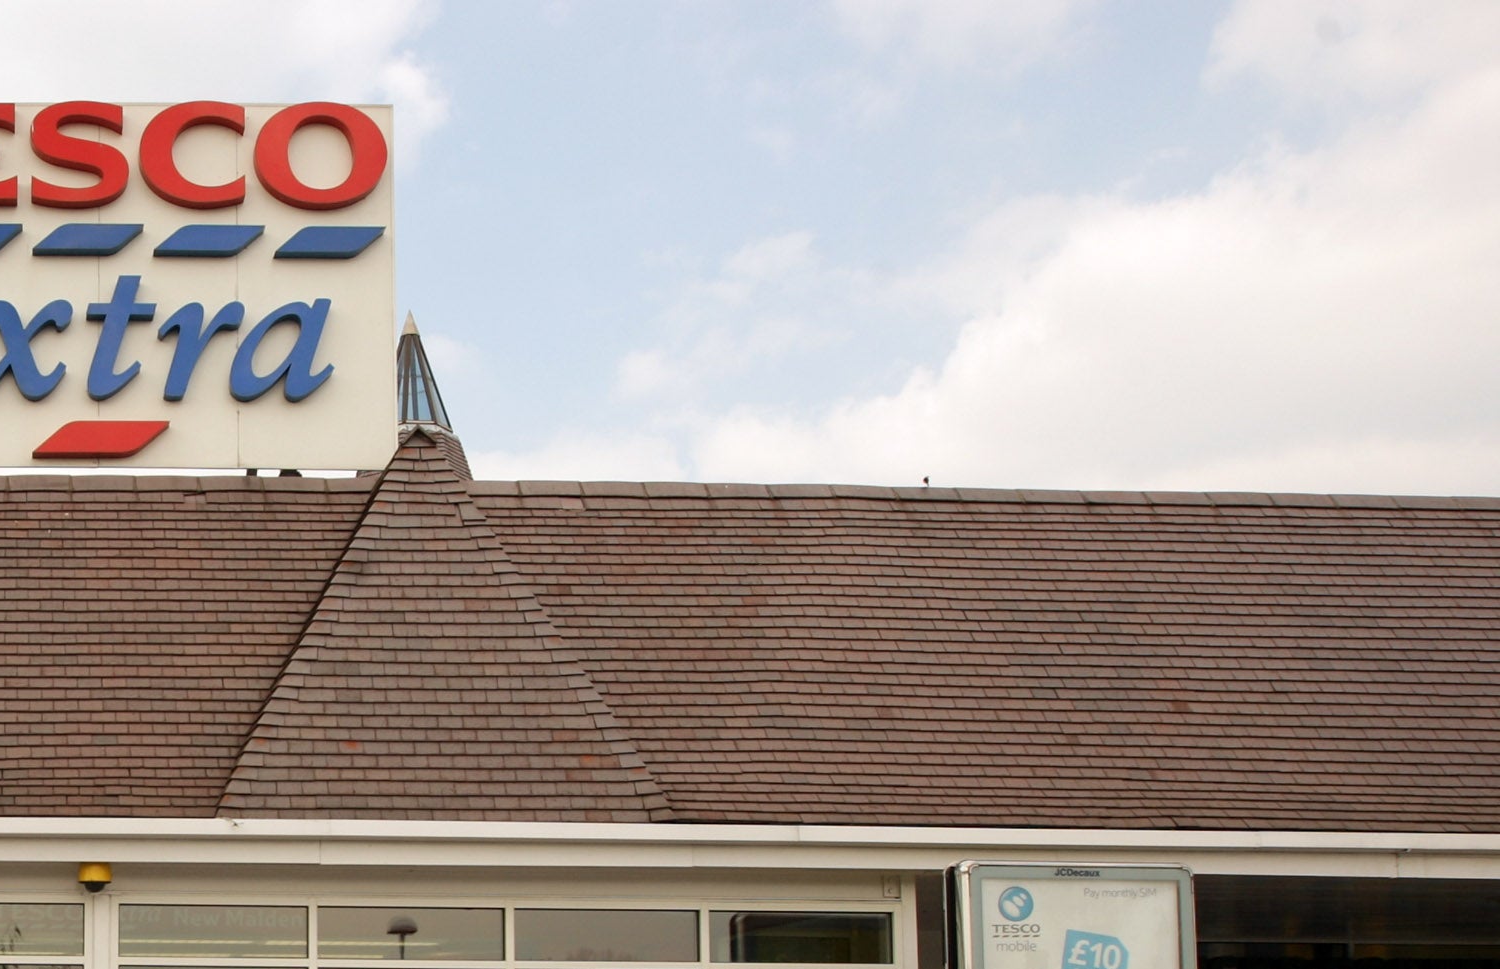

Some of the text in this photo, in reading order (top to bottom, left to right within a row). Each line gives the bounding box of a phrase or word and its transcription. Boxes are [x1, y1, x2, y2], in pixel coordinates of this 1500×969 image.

[1055, 868, 1100, 877] JCDecaux
[1084, 887, 1157, 899] Pay monthly SIM
[992, 923, 1040, 934] TESCO
[996, 941, 1037, 952] mobile
